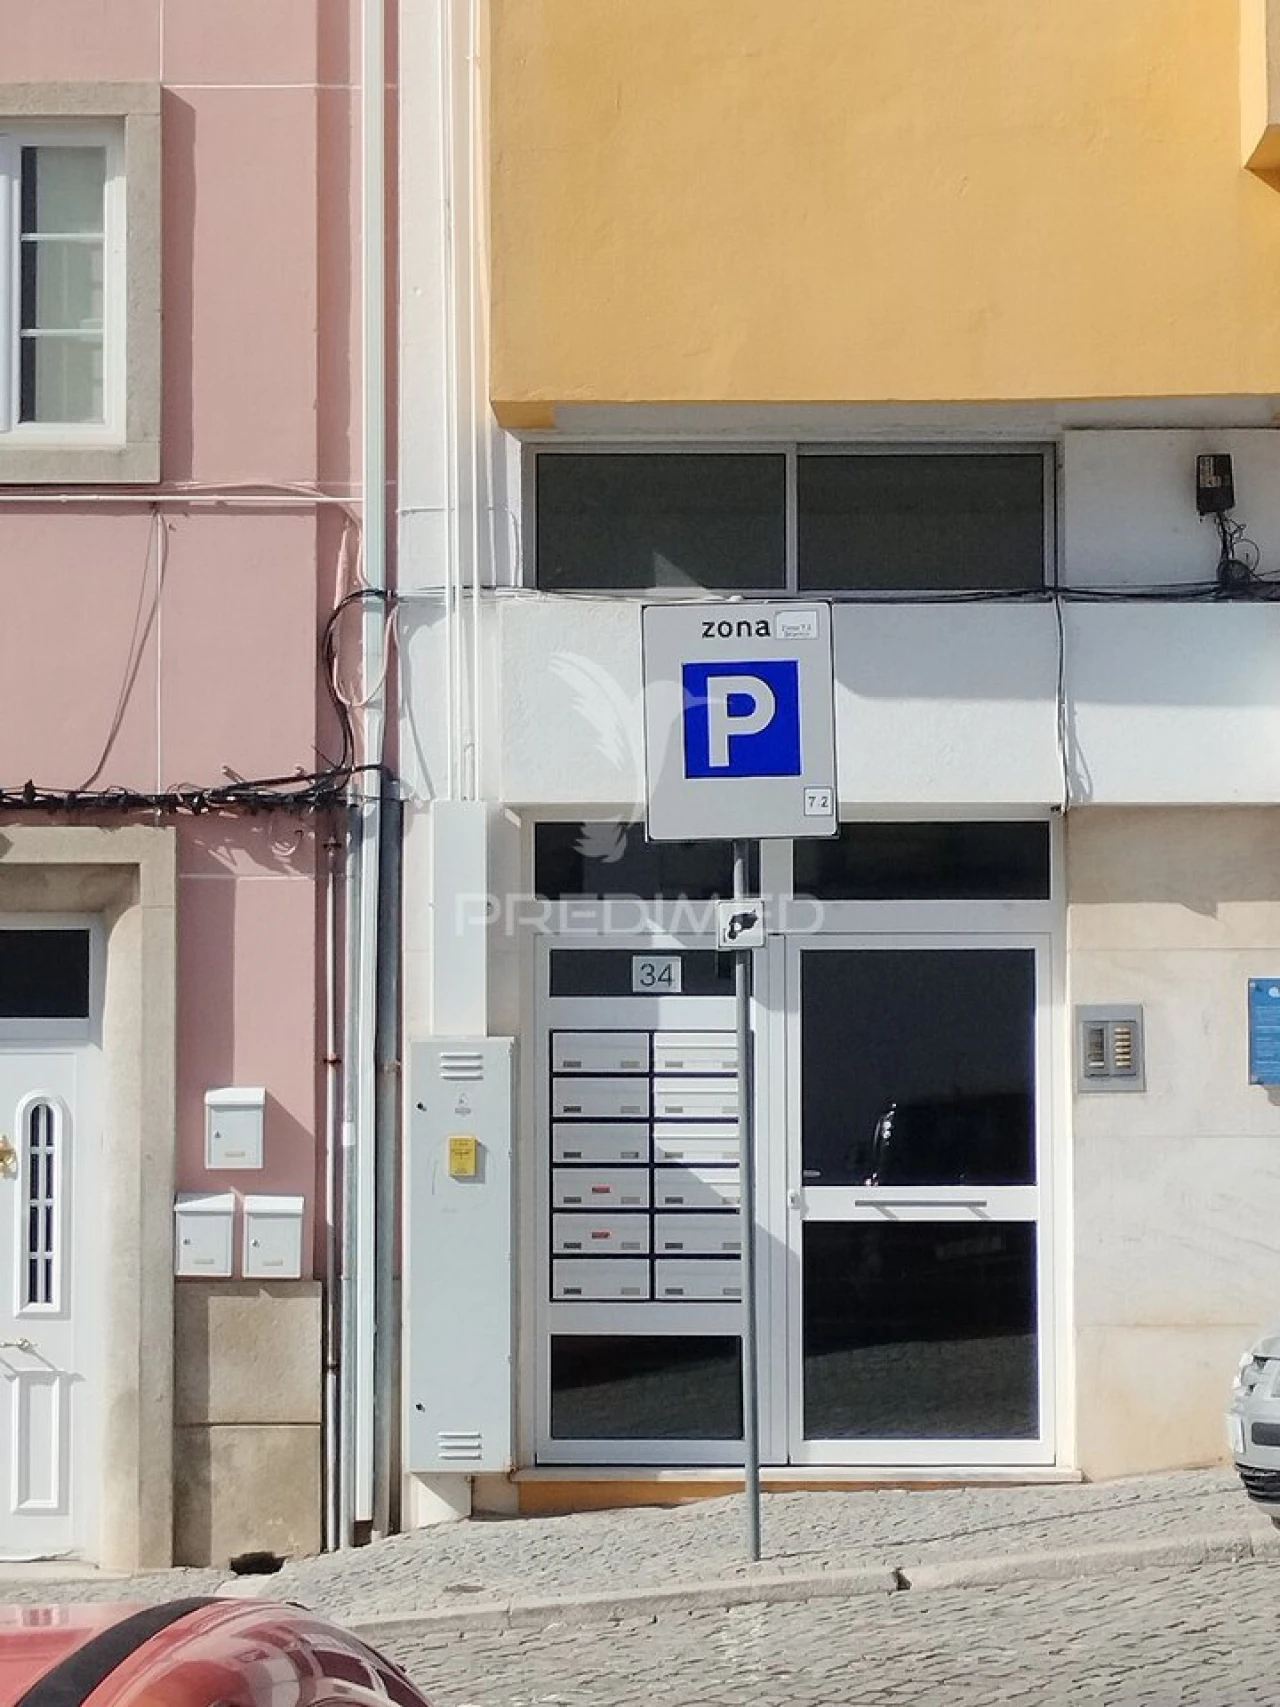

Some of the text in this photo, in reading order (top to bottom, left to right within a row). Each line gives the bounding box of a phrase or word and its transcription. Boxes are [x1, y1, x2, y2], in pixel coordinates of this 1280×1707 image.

[701, 620, 771, 638] zona
[706, 675, 776, 768] P
[640, 963, 674, 987] 34
